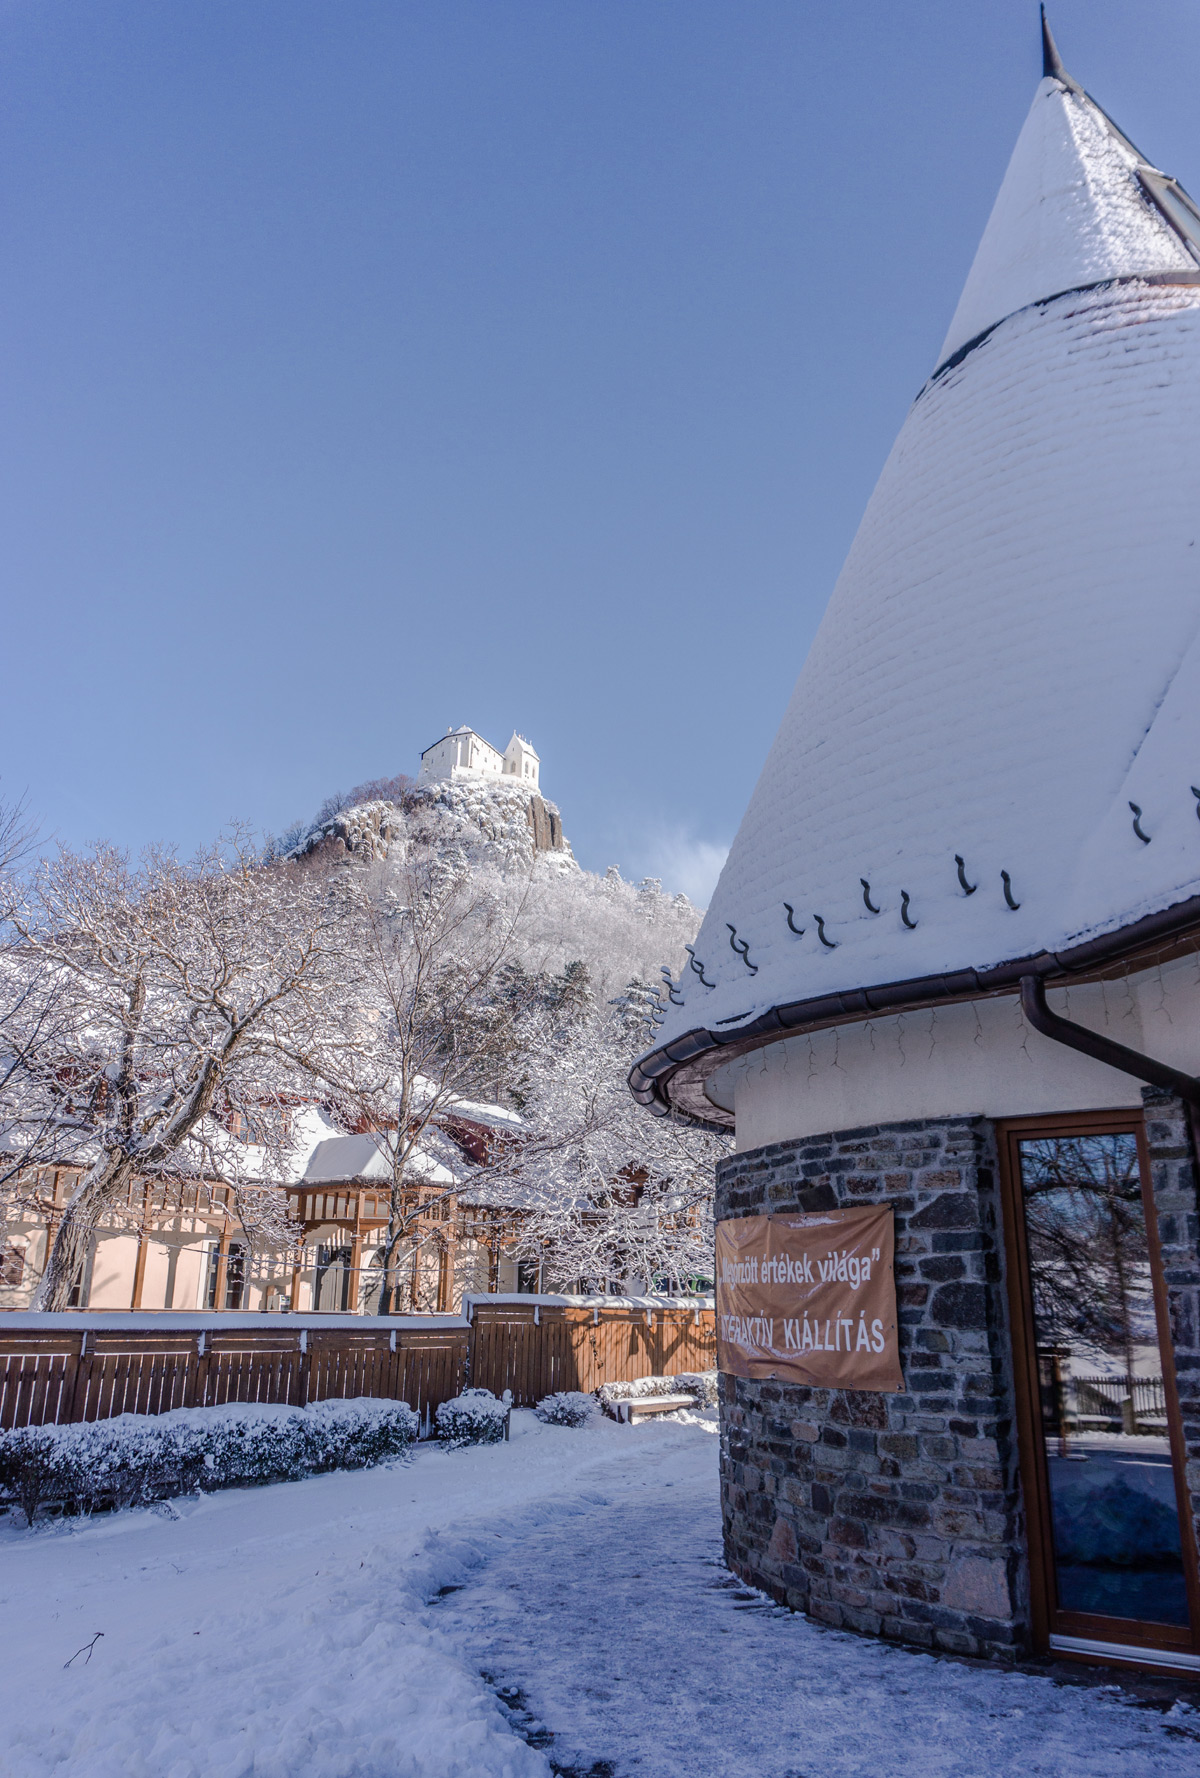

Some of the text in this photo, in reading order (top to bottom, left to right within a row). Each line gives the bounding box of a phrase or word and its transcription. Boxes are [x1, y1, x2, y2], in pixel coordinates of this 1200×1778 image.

[761, 1252, 815, 1284] értékek
[817, 1247, 881, 1290] világa”
[720, 1309, 886, 1354] NTERAKTÍV KIÁLLÍTÁS
